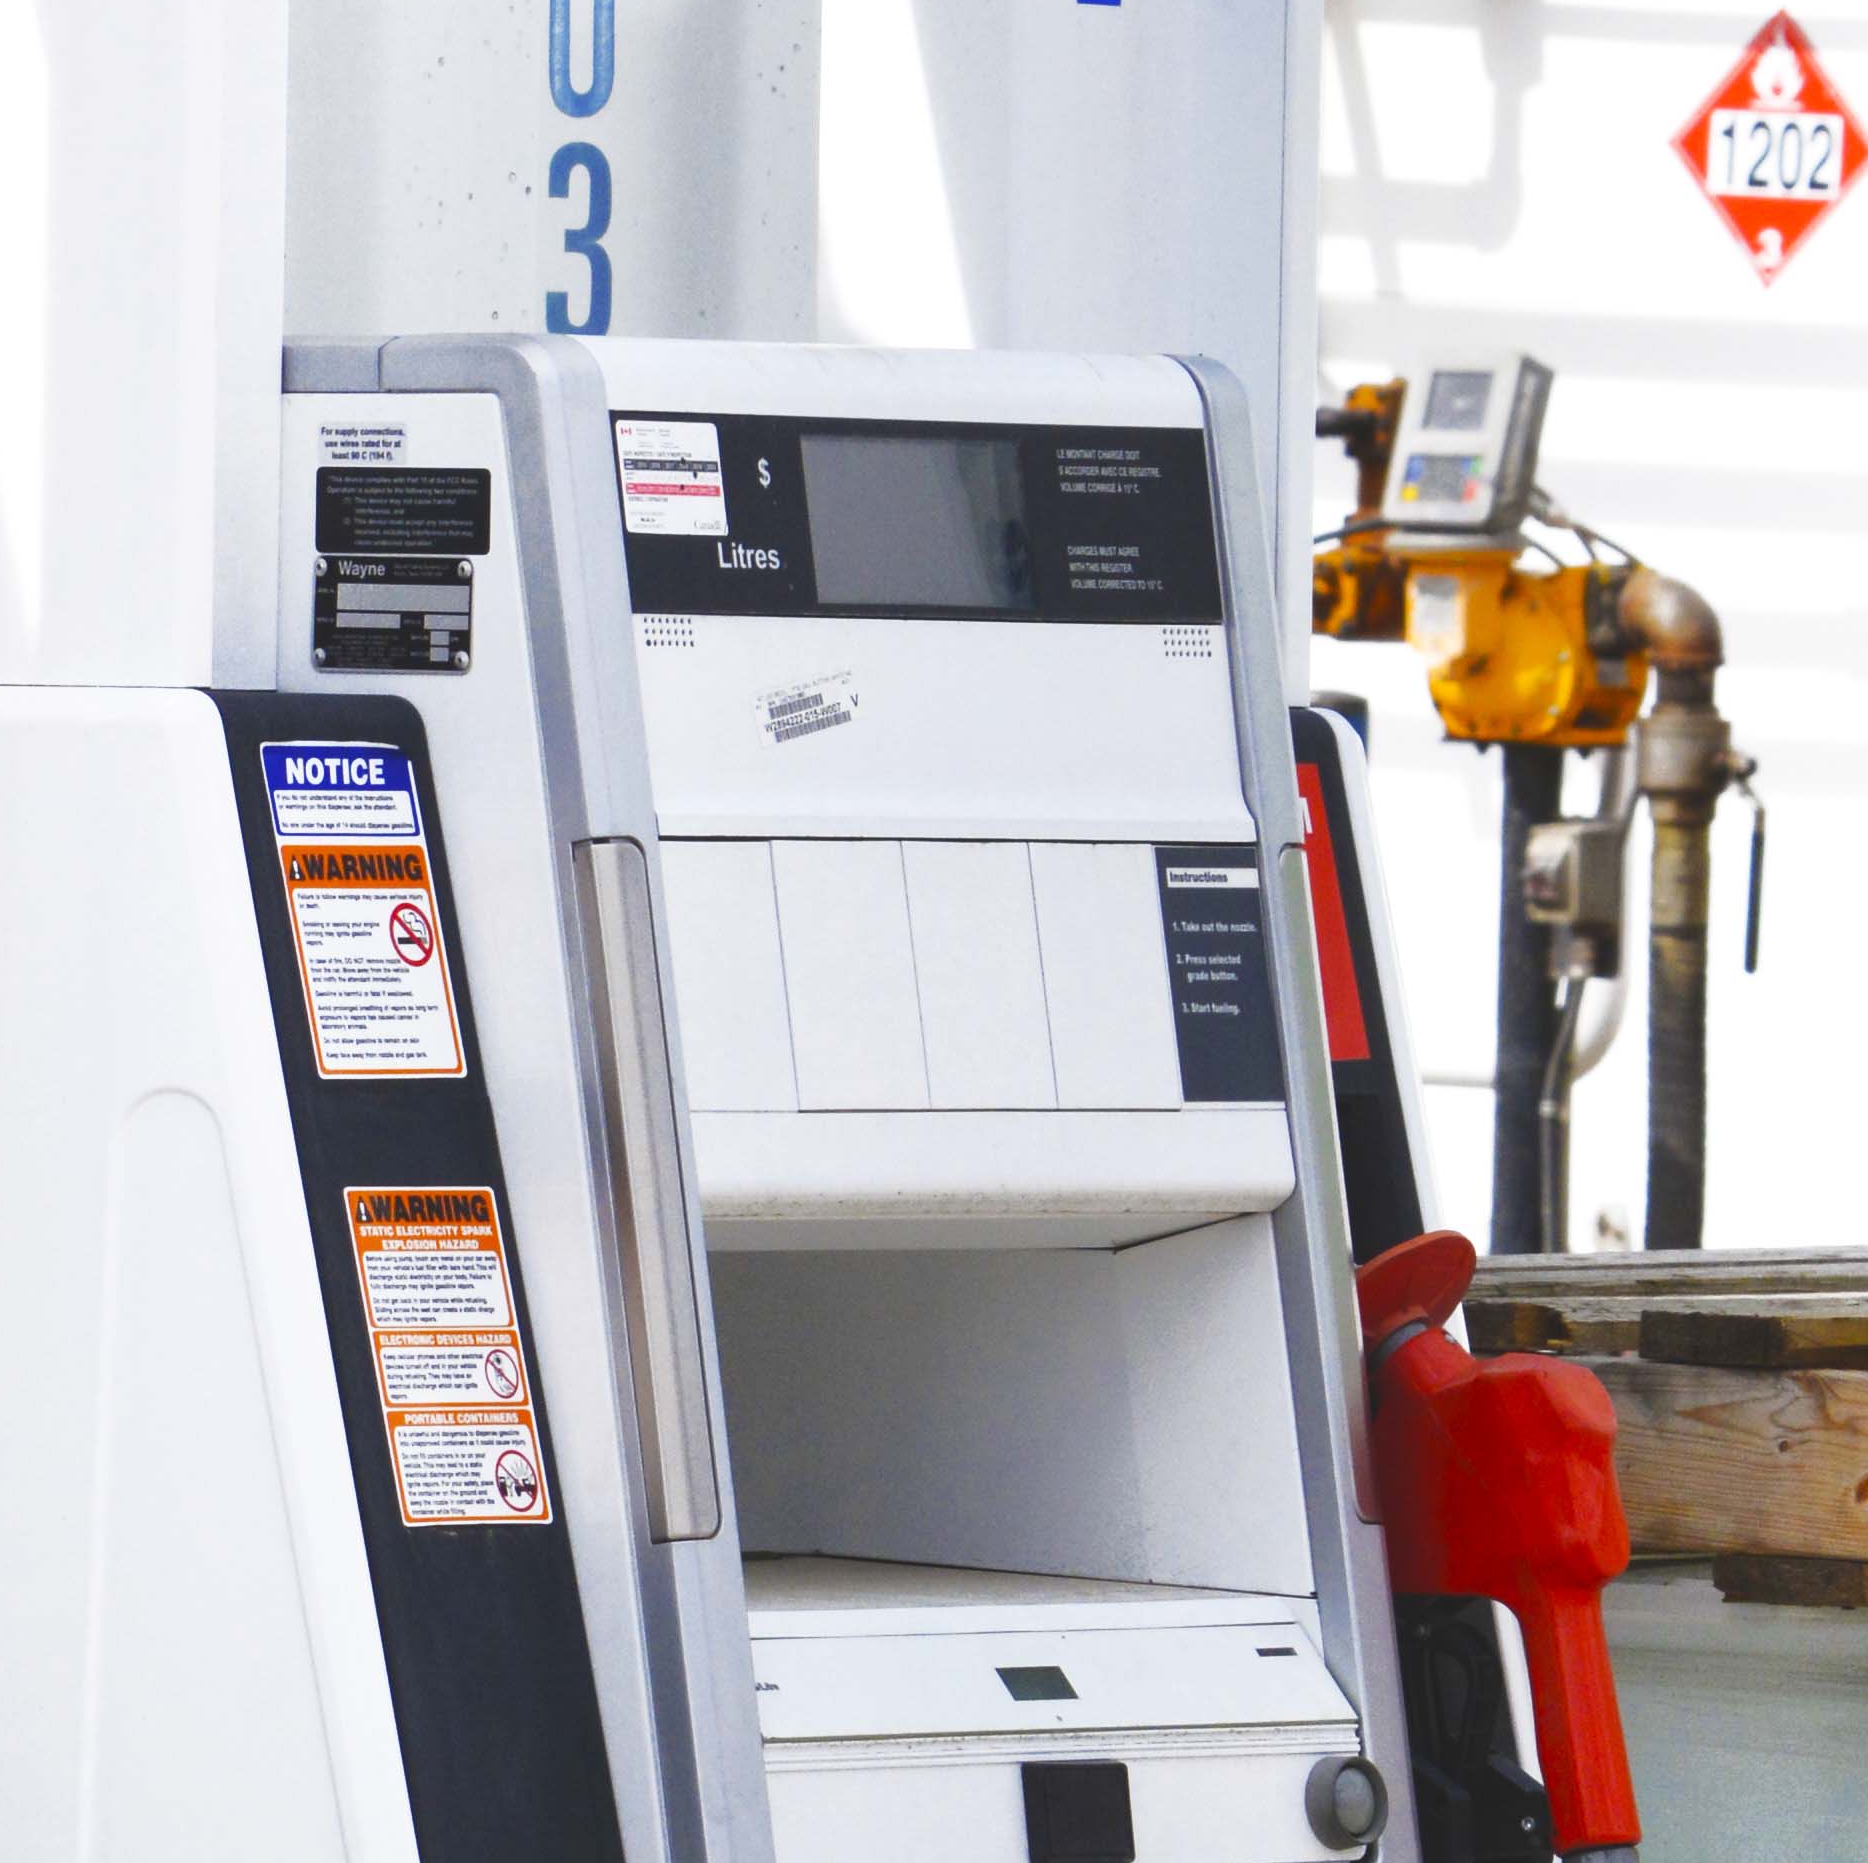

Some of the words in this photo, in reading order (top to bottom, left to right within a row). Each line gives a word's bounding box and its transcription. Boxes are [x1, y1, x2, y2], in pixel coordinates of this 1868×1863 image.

[1722, 120, 1833, 190] 1202
[321, 426, 332, 436] For
[335, 428, 358, 438] supply
[340, 440, 360, 448] wires
[361, 440, 380, 448] rated
[382, 440, 392, 448] for
[394, 440, 402, 448] at
[758, 458, 772, 488] $
[718, 540, 781, 571] Litres
[338, 560, 386, 579] Wayne
[284, 758, 386, 786] NOTICE
[305, 854, 424, 882] WARNING
[1169, 872, 1228, 883] Instructions
[1181, 921, 1200, 932] Take
[1202, 922, 1214, 932] out
[1216, 922, 1229, 932] the
[1185, 954, 1207, 965] Press
[1208, 954, 1242, 965] selected
[1187, 972, 1209, 984] grade
[1190, 1002, 1210, 1014] Start
[370, 1195, 490, 1223] WARNING
[360, 1225, 394, 1236] STATIC
[396, 1225, 459, 1236] ELECTRICITY
[461, 1225, 492, 1236] SPARK
[382, 1239, 437, 1250] EXPLOSION
[439, 1239, 480, 1250] HAZARD
[380, 1334, 435, 1346] ELECTRONIC
[436, 1334, 474, 1345] DEVICES
[476, 1333, 512, 1344] HAZARD
[404, 1413, 456, 1425] PORTABLE
[456, 1412, 520, 1424] CONTAINERS
